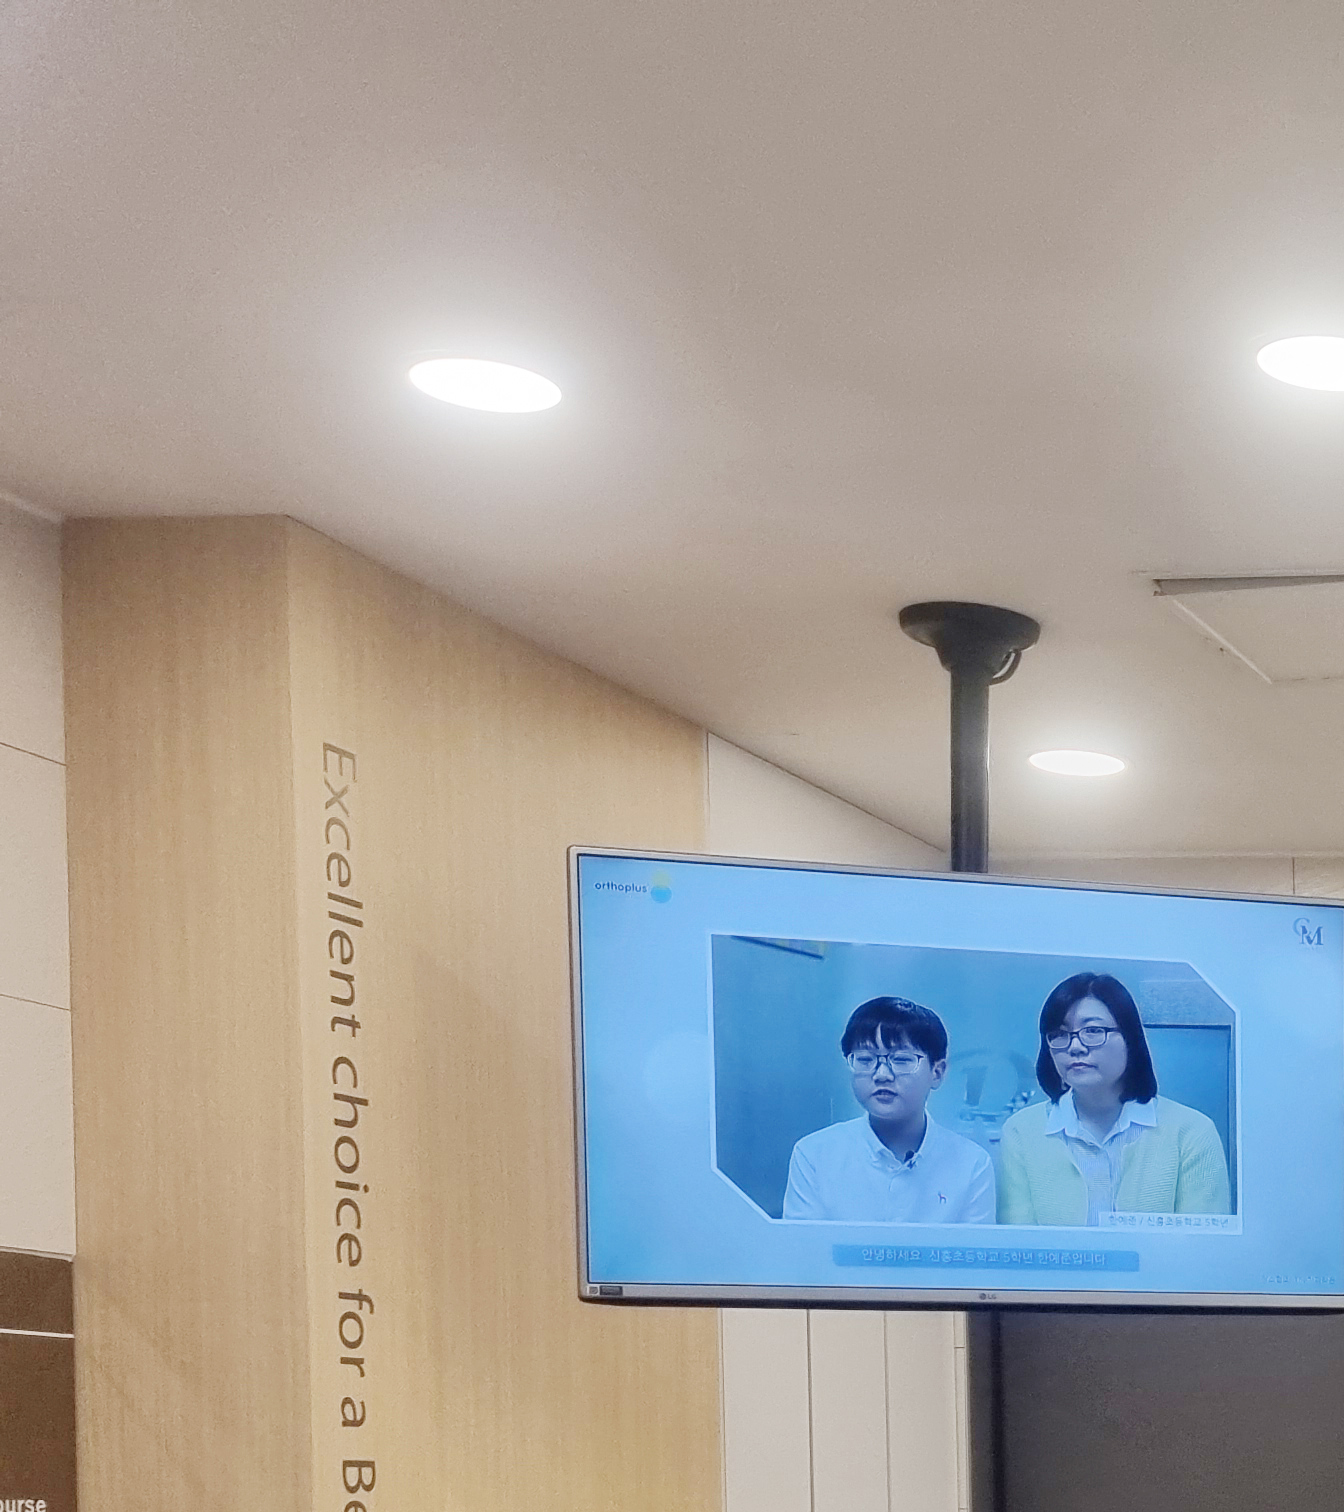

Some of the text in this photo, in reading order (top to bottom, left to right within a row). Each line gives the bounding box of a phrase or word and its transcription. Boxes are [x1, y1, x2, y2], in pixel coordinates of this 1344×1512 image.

[323, 742, 364, 1038] Excellent
[594, 881, 648, 893] orthoplus
[332, 1056, 370, 1267] choice
[338, 1289, 375, 1378] for
[341, 1397, 367, 1428] a
